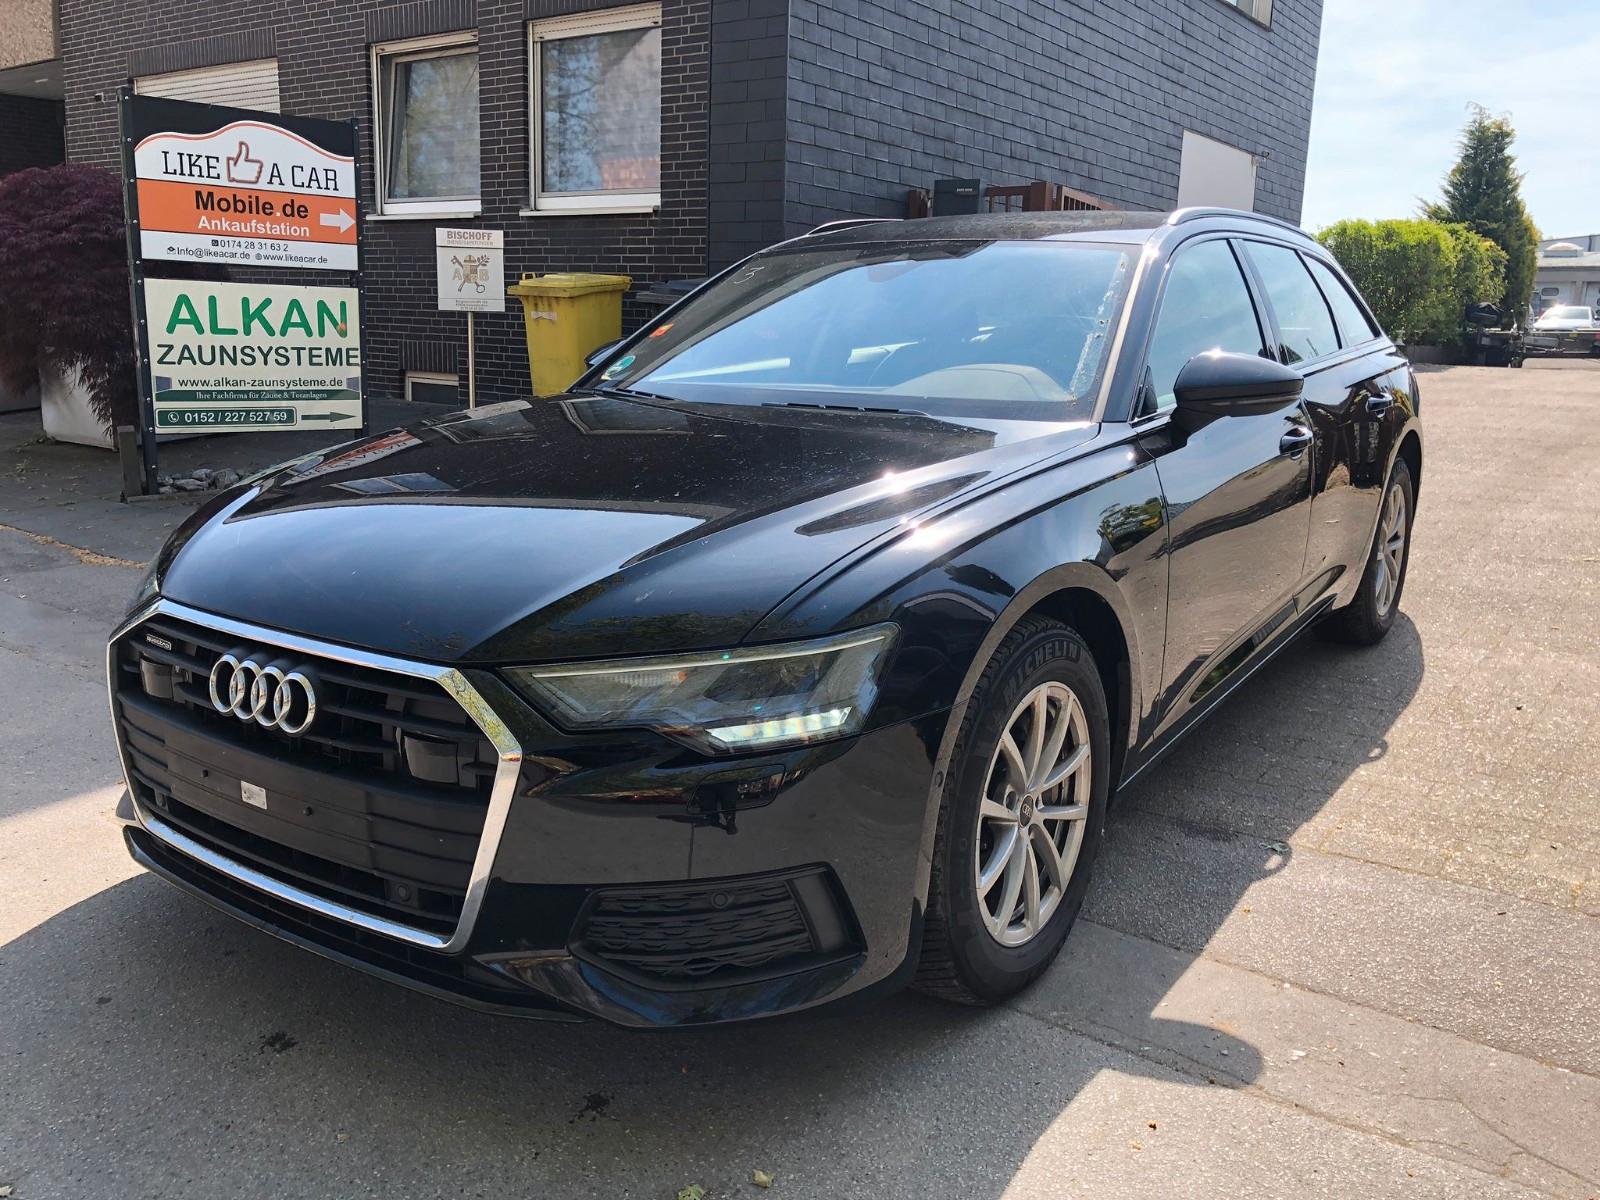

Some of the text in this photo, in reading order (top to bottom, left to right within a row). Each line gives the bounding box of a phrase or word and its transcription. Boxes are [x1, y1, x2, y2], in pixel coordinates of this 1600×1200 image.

[161, 150, 339, 192] LIKE A CAR
[194, 190, 309, 219] Mobile.de
[198, 215, 310, 237] Ankaufstation
[447, 230, 493, 241] BISCHOFF
[220, 239, 289, 251] 0174 28 31 63 2
[177, 246, 328, 264] Info@likeacar.de www.likeacar.de
[165, 293, 348, 339] ALKAN
[156, 343, 361, 367] ZAUNSYSTEME
[178, 376, 343, 390] www.alkan-zaunsysteme.de
[196, 391, 328, 400] Ihre Fachfirma für Zäune & Toranlagen
[184, 412, 215, 423] 0152
[224, 412, 246, 422] 227
[249, 412, 270, 422] 527
[273, 411, 287, 421] 59
